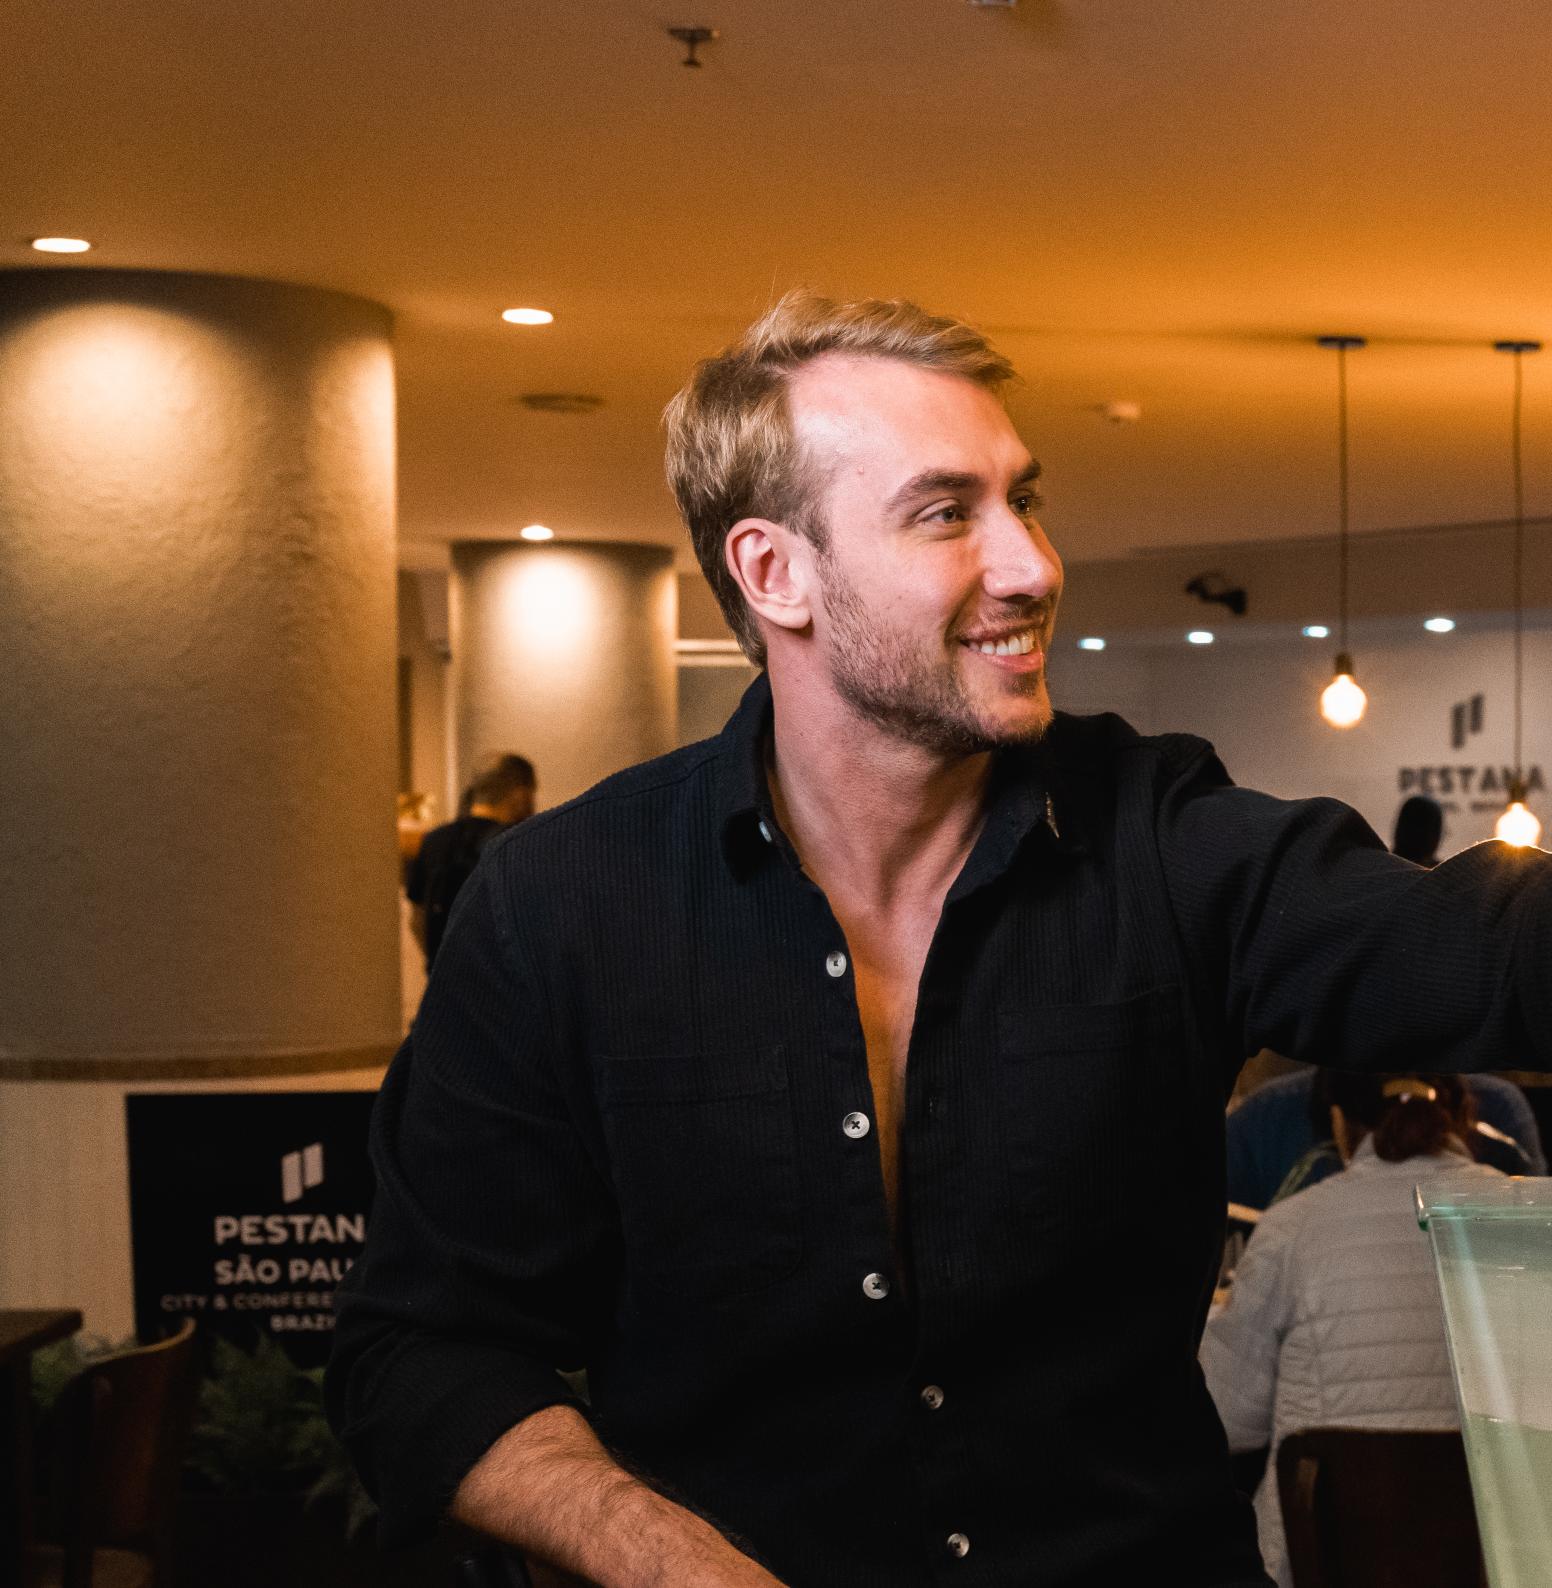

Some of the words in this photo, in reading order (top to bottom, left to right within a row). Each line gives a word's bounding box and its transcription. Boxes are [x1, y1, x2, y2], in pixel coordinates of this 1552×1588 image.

[1398, 764, 1546, 794] PESTANA
[213, 1213, 365, 1246] PESTAN
[213, 1253, 282, 1286] SÃO
[288, 1257, 354, 1284] PAU
[159, 1293, 206, 1312] CITY
[232, 1291, 334, 1311] CONFERE
